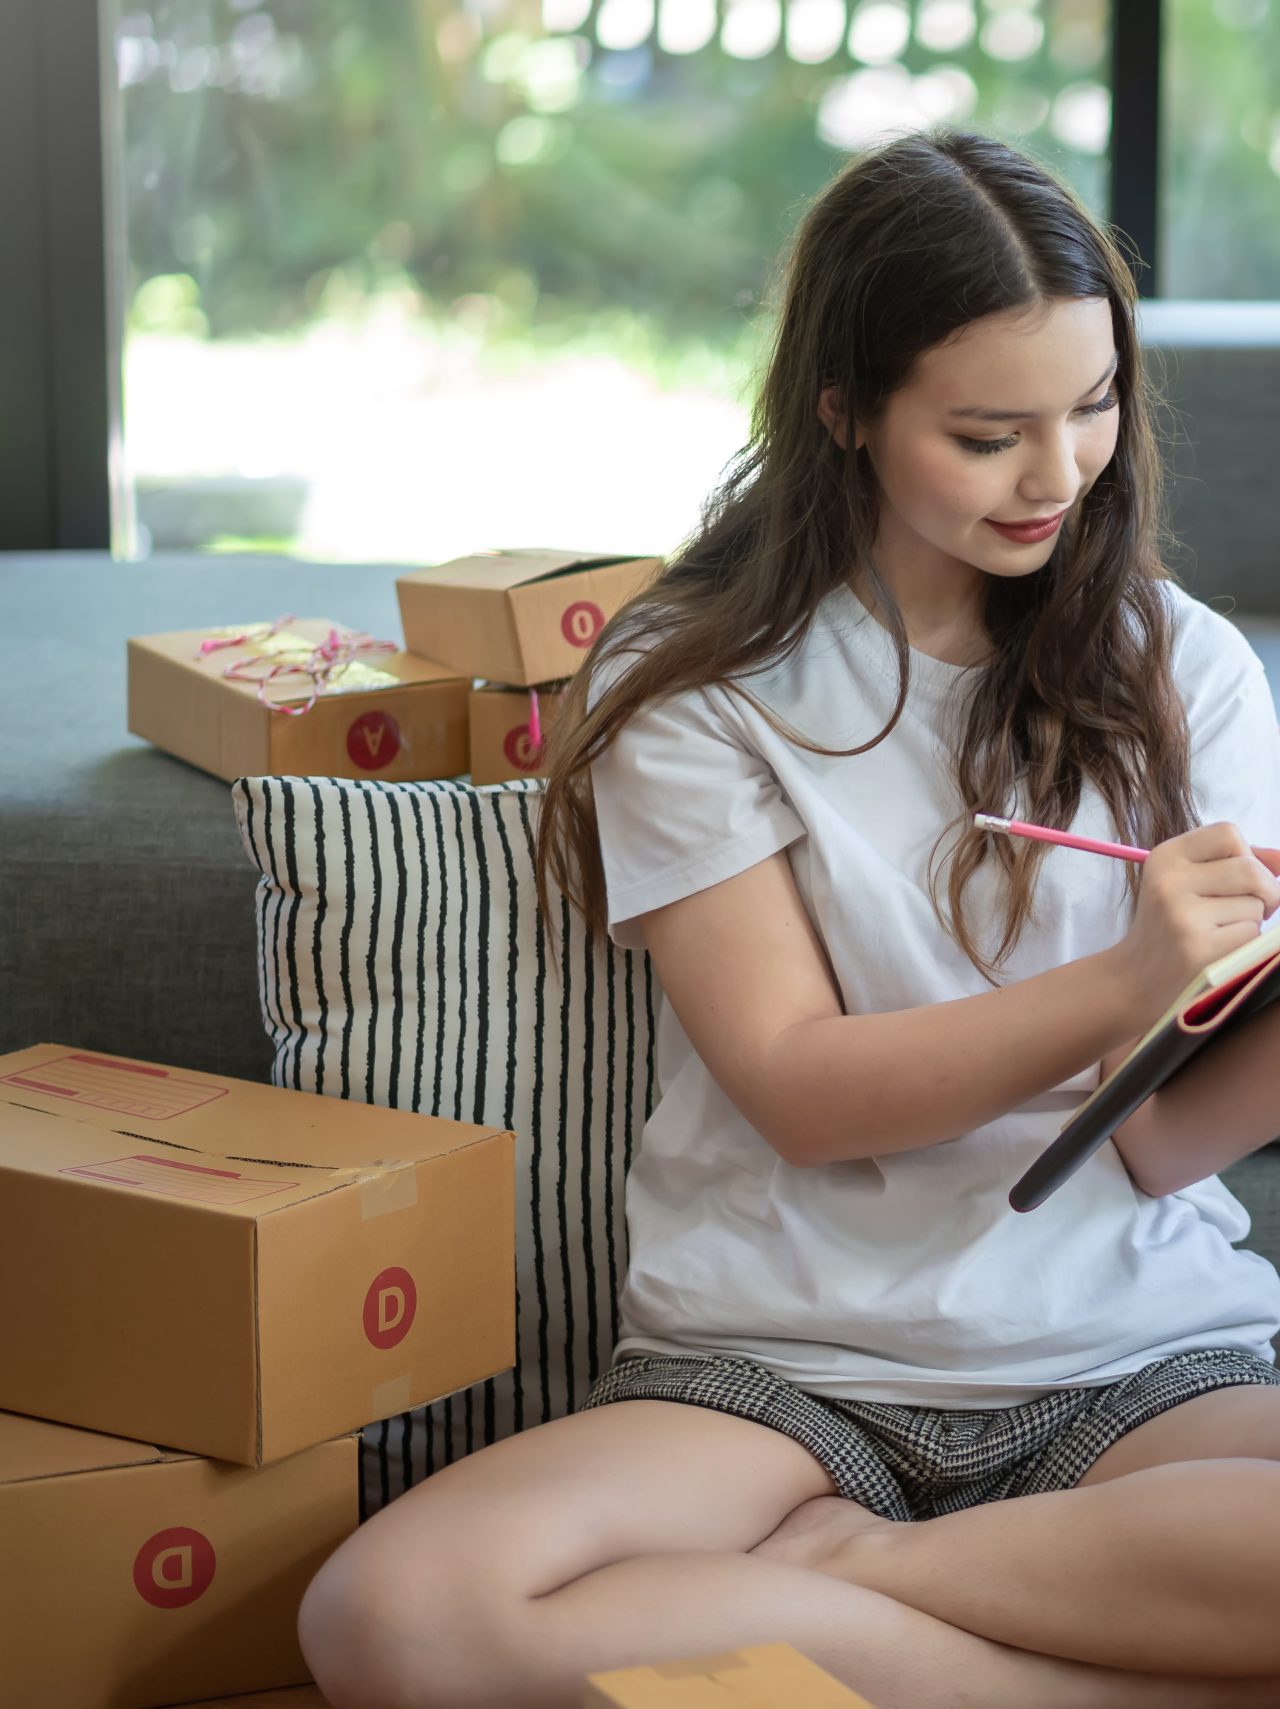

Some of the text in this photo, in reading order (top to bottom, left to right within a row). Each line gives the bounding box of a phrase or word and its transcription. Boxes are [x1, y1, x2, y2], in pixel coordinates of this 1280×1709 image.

[363, 724, 384, 757] A
[378, 1286, 405, 1333] D
[152, 1545, 193, 1589] D
